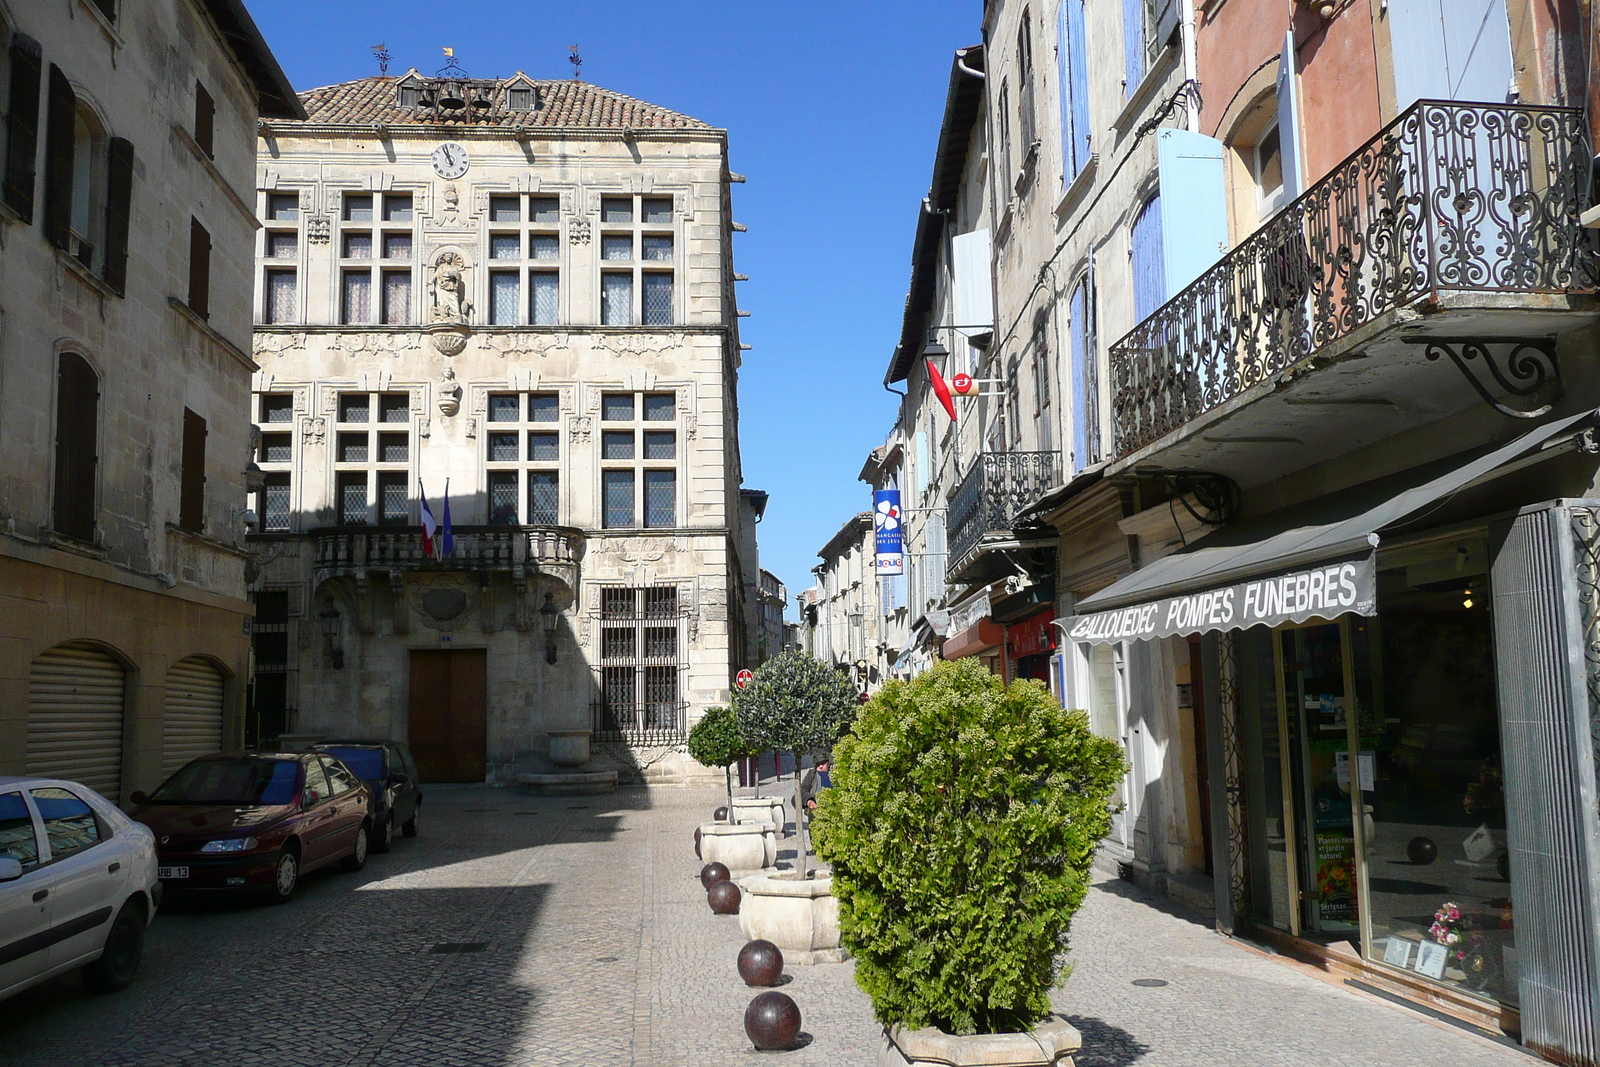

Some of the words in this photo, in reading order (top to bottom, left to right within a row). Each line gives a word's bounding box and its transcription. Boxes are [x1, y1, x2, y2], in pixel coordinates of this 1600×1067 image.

[1070, 604, 1158, 639] GALLOUÉDEC
[1165, 588, 1234, 629] POMPES
[1244, 564, 1357, 619] FUNÈBRES
[1325, 844, 1345, 853] jardin
[177, 868, 187, 877] 13
